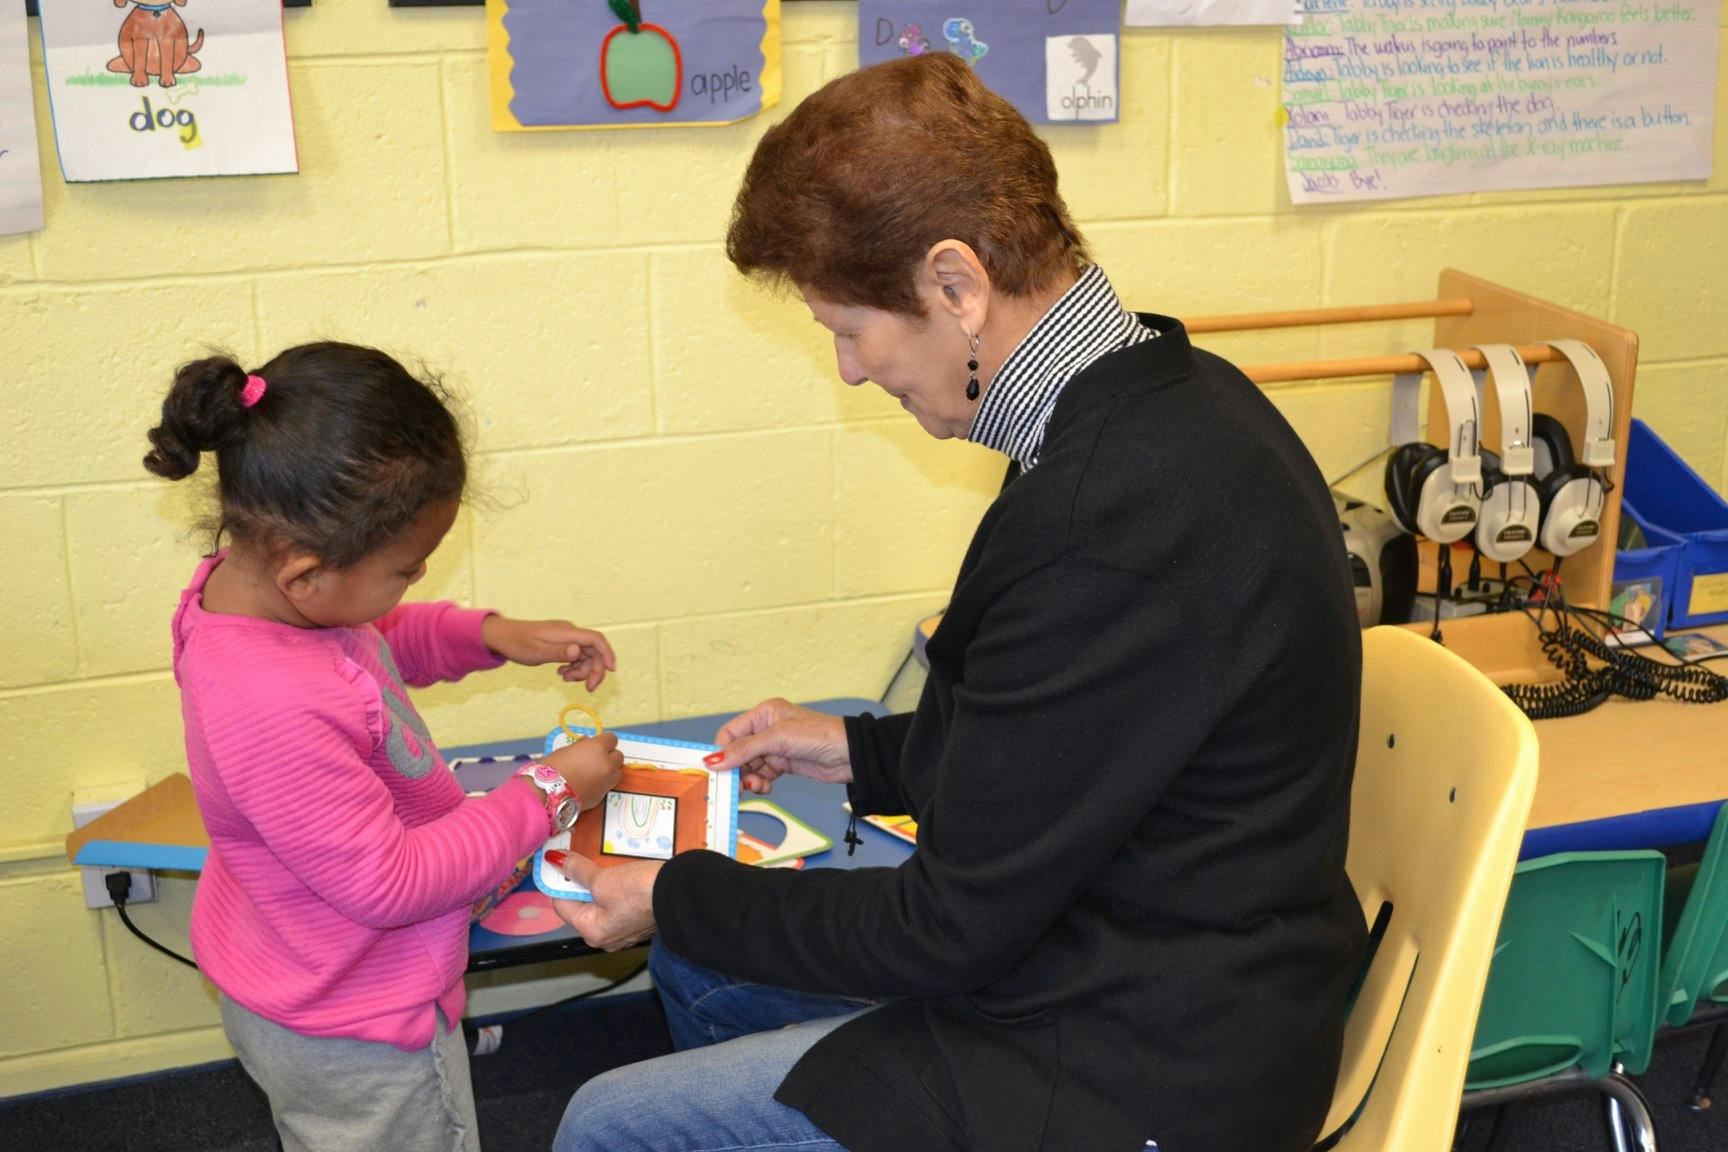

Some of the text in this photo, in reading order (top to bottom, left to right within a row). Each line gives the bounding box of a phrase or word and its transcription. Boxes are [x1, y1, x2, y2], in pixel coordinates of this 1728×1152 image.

[1620, 3, 1650, 23] feels
[876, 17, 893, 46] D
[1521, 29, 1537, 50] to
[1540, 26, 1560, 48] the
[1380, 61, 1395, 77] is
[1395, 52, 1445, 80] looking
[1462, 58, 1483, 73] see
[1502, 48, 1522, 72] the
[1551, 55, 1564, 70] is
[1567, 47, 1619, 74] healthy
[1622, 52, 1637, 66] or
[690, 64, 751, 103] apple
[1431, 74, 1479, 101] looking
[1421, 103, 1435, 116] is
[1496, 93, 1522, 116] the
[129, 96, 198, 144] dog
[1381, 122, 1441, 148] checking
[1443, 118, 1467, 141] the
[1537, 110, 1567, 134] and
[1570, 109, 1605, 132] there
